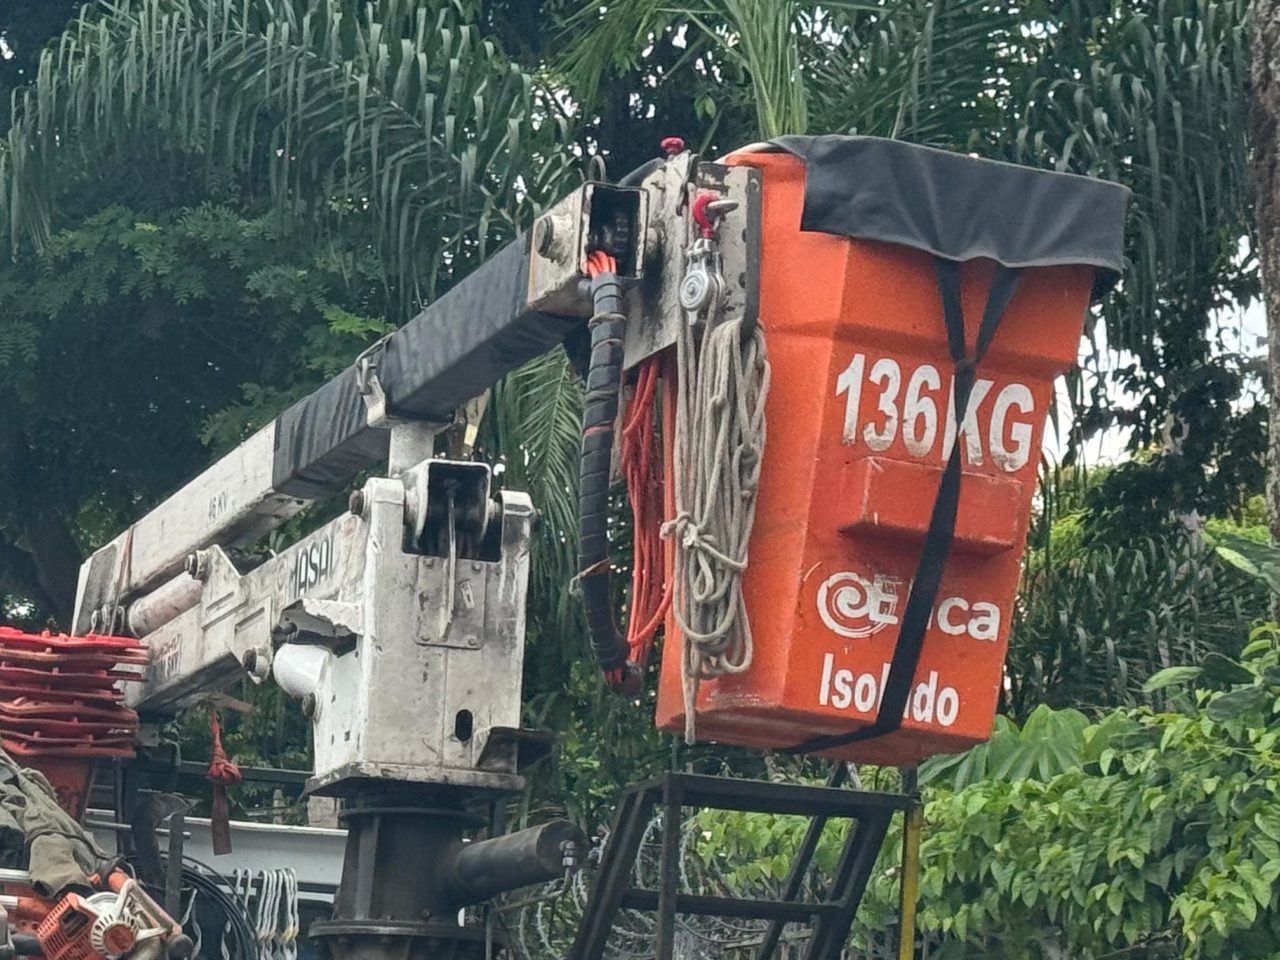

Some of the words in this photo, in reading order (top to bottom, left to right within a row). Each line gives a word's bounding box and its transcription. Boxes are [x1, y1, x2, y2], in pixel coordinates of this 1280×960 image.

[835, 353, 1035, 473] 136KG
[869, 573, 1001, 642] Eca
[819, 652, 960, 727] Isoldo
